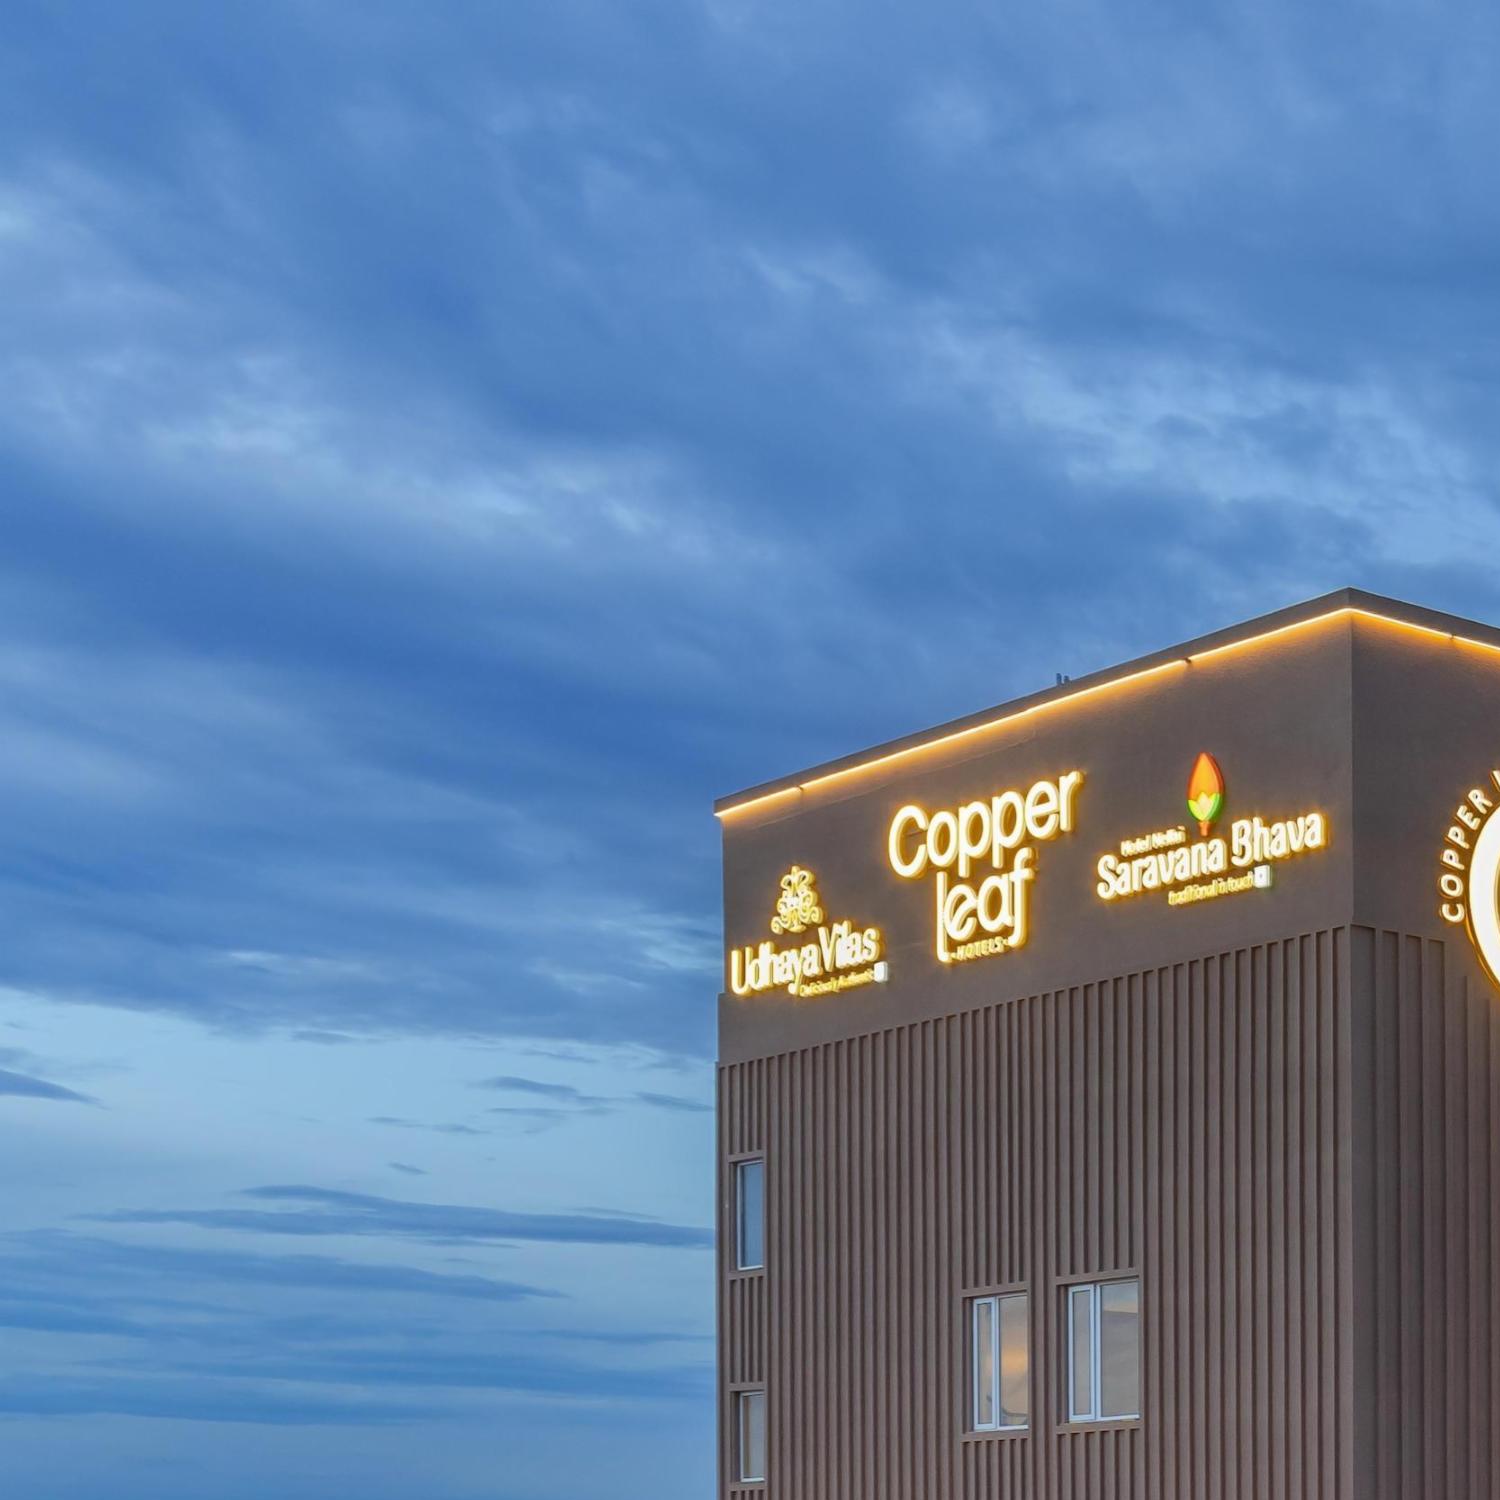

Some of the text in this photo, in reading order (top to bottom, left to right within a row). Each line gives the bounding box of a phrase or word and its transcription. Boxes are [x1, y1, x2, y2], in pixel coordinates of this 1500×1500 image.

[888, 770, 1083, 878] Copper
[1096, 812, 1325, 900] Saravana Bhava
[1439, 788, 1493, 922] COPPER
[731, 920, 880, 996] Udhaya Vilas
